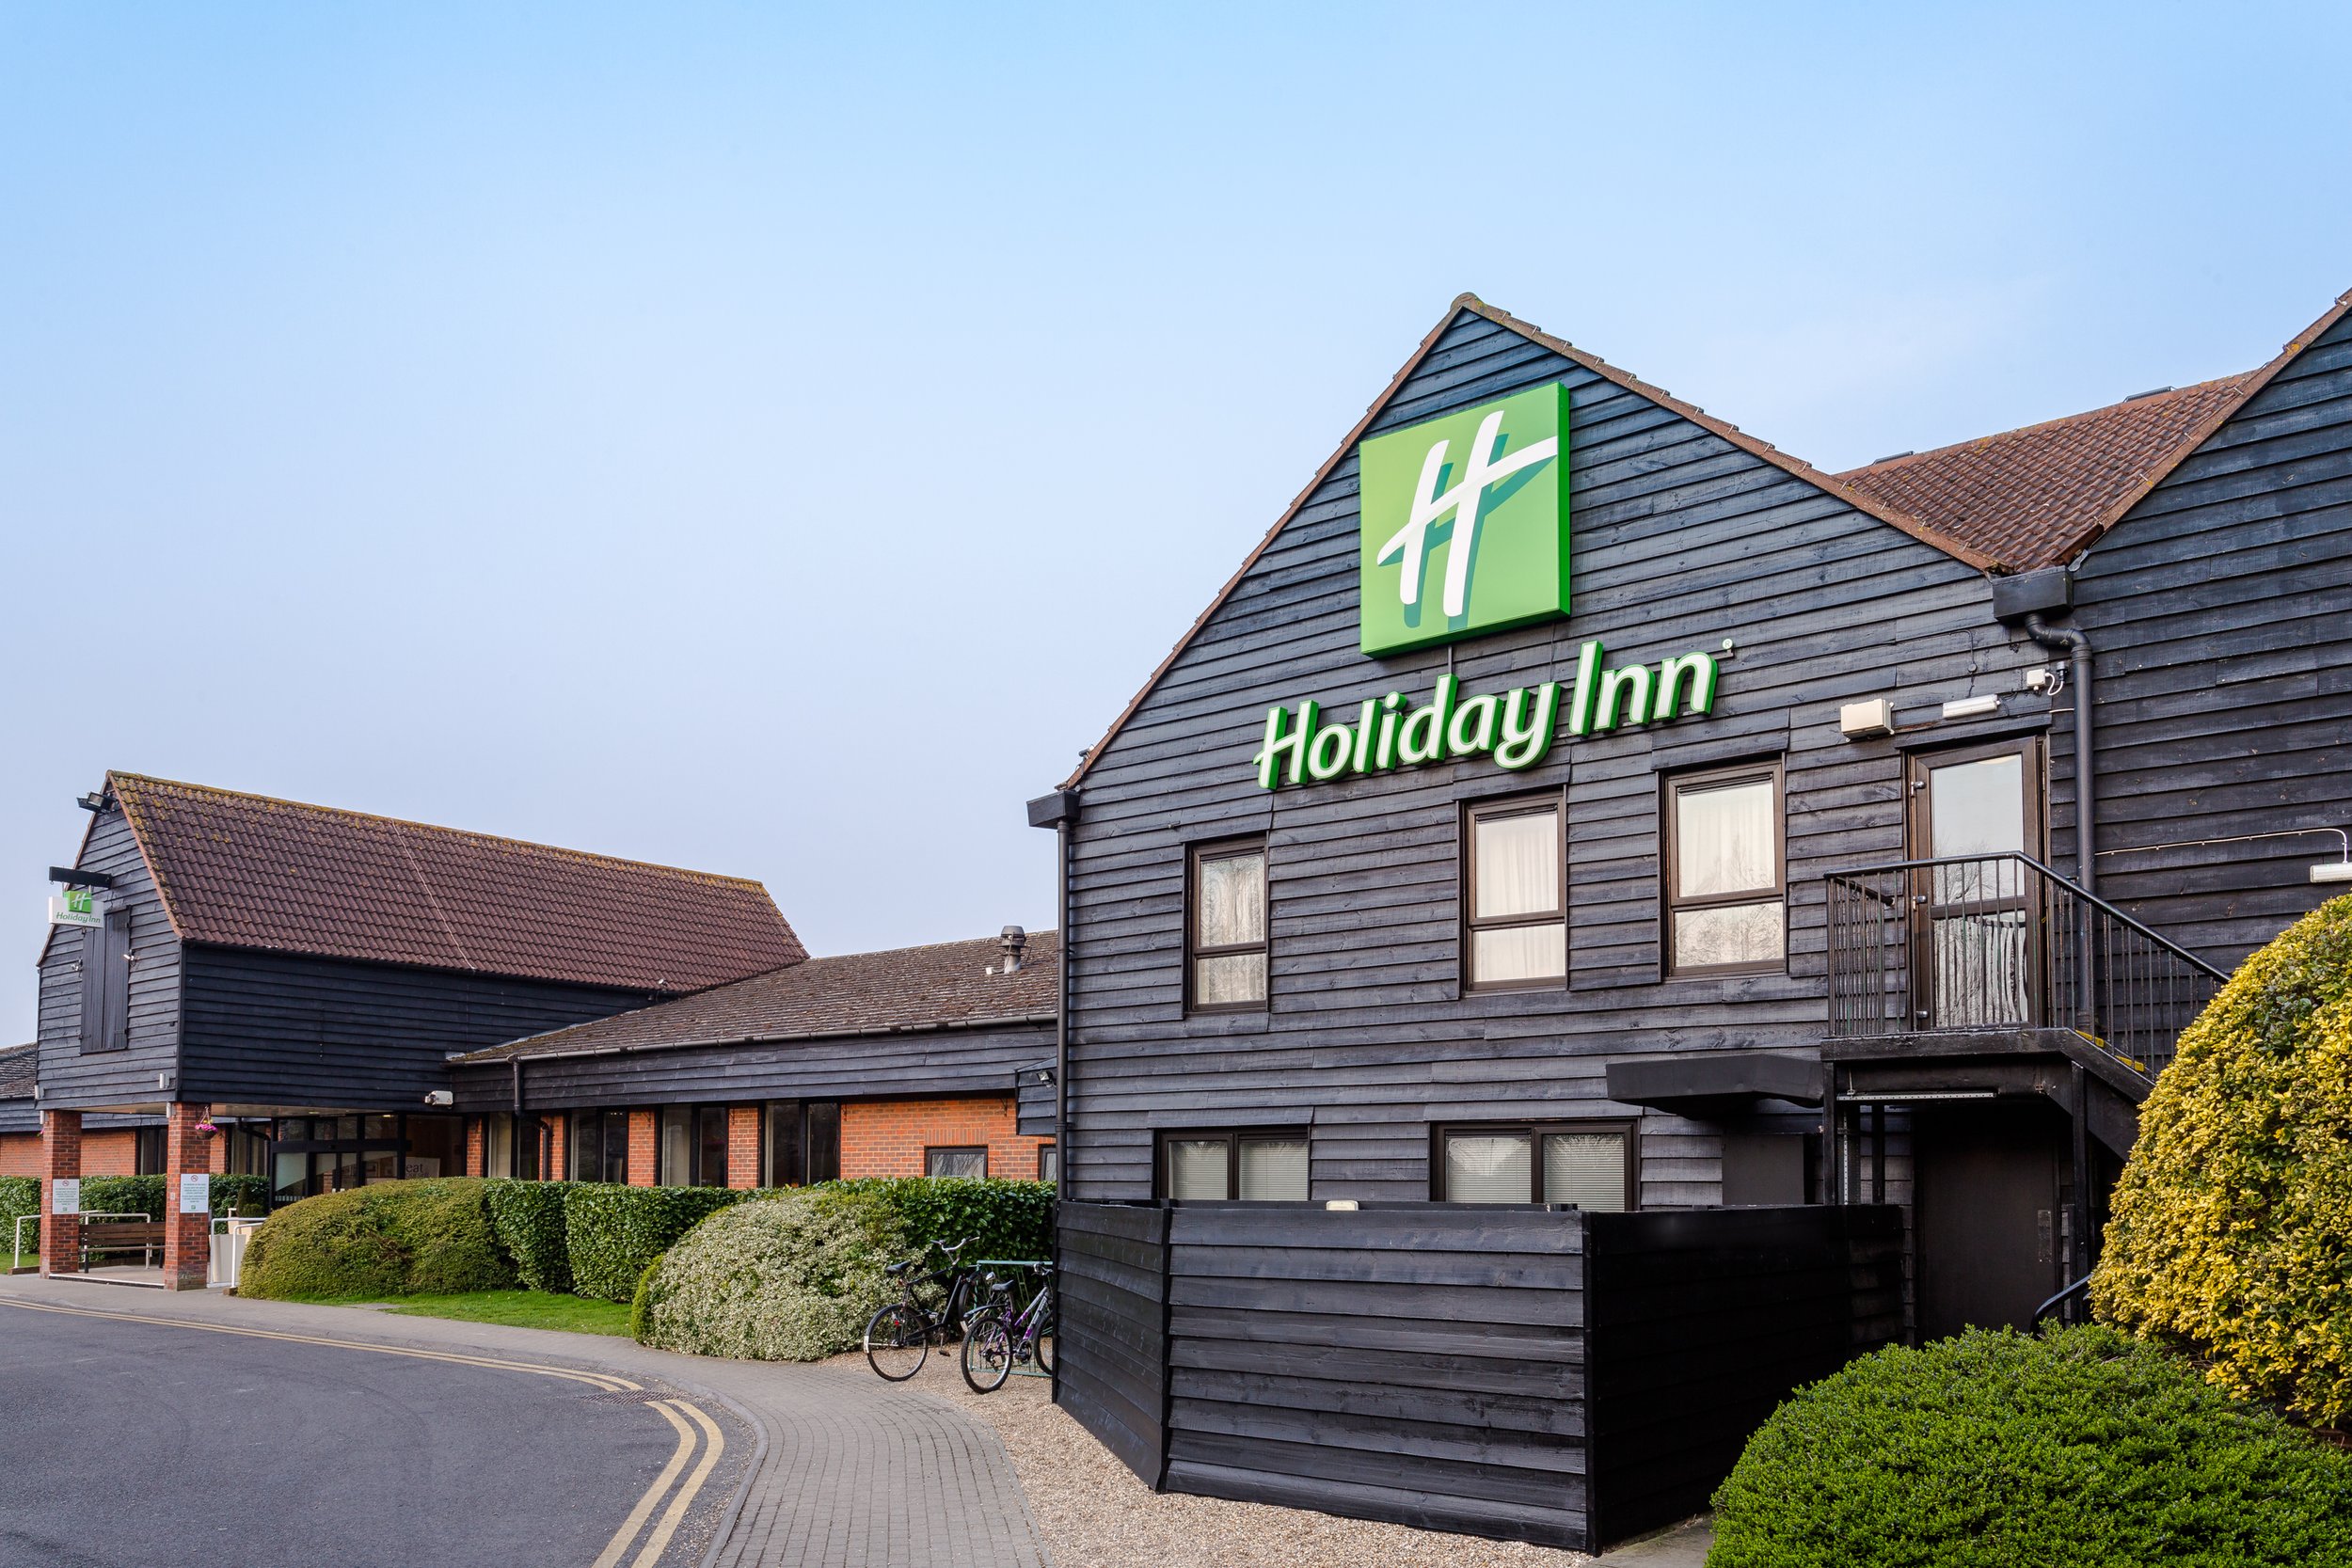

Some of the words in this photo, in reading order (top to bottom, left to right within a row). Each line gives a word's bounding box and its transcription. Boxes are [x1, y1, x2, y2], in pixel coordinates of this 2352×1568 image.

[1253, 673, 1562, 790] Holiday
[56, 911, 88, 924] Holiday
[88, 914, 101, 924] Inn
